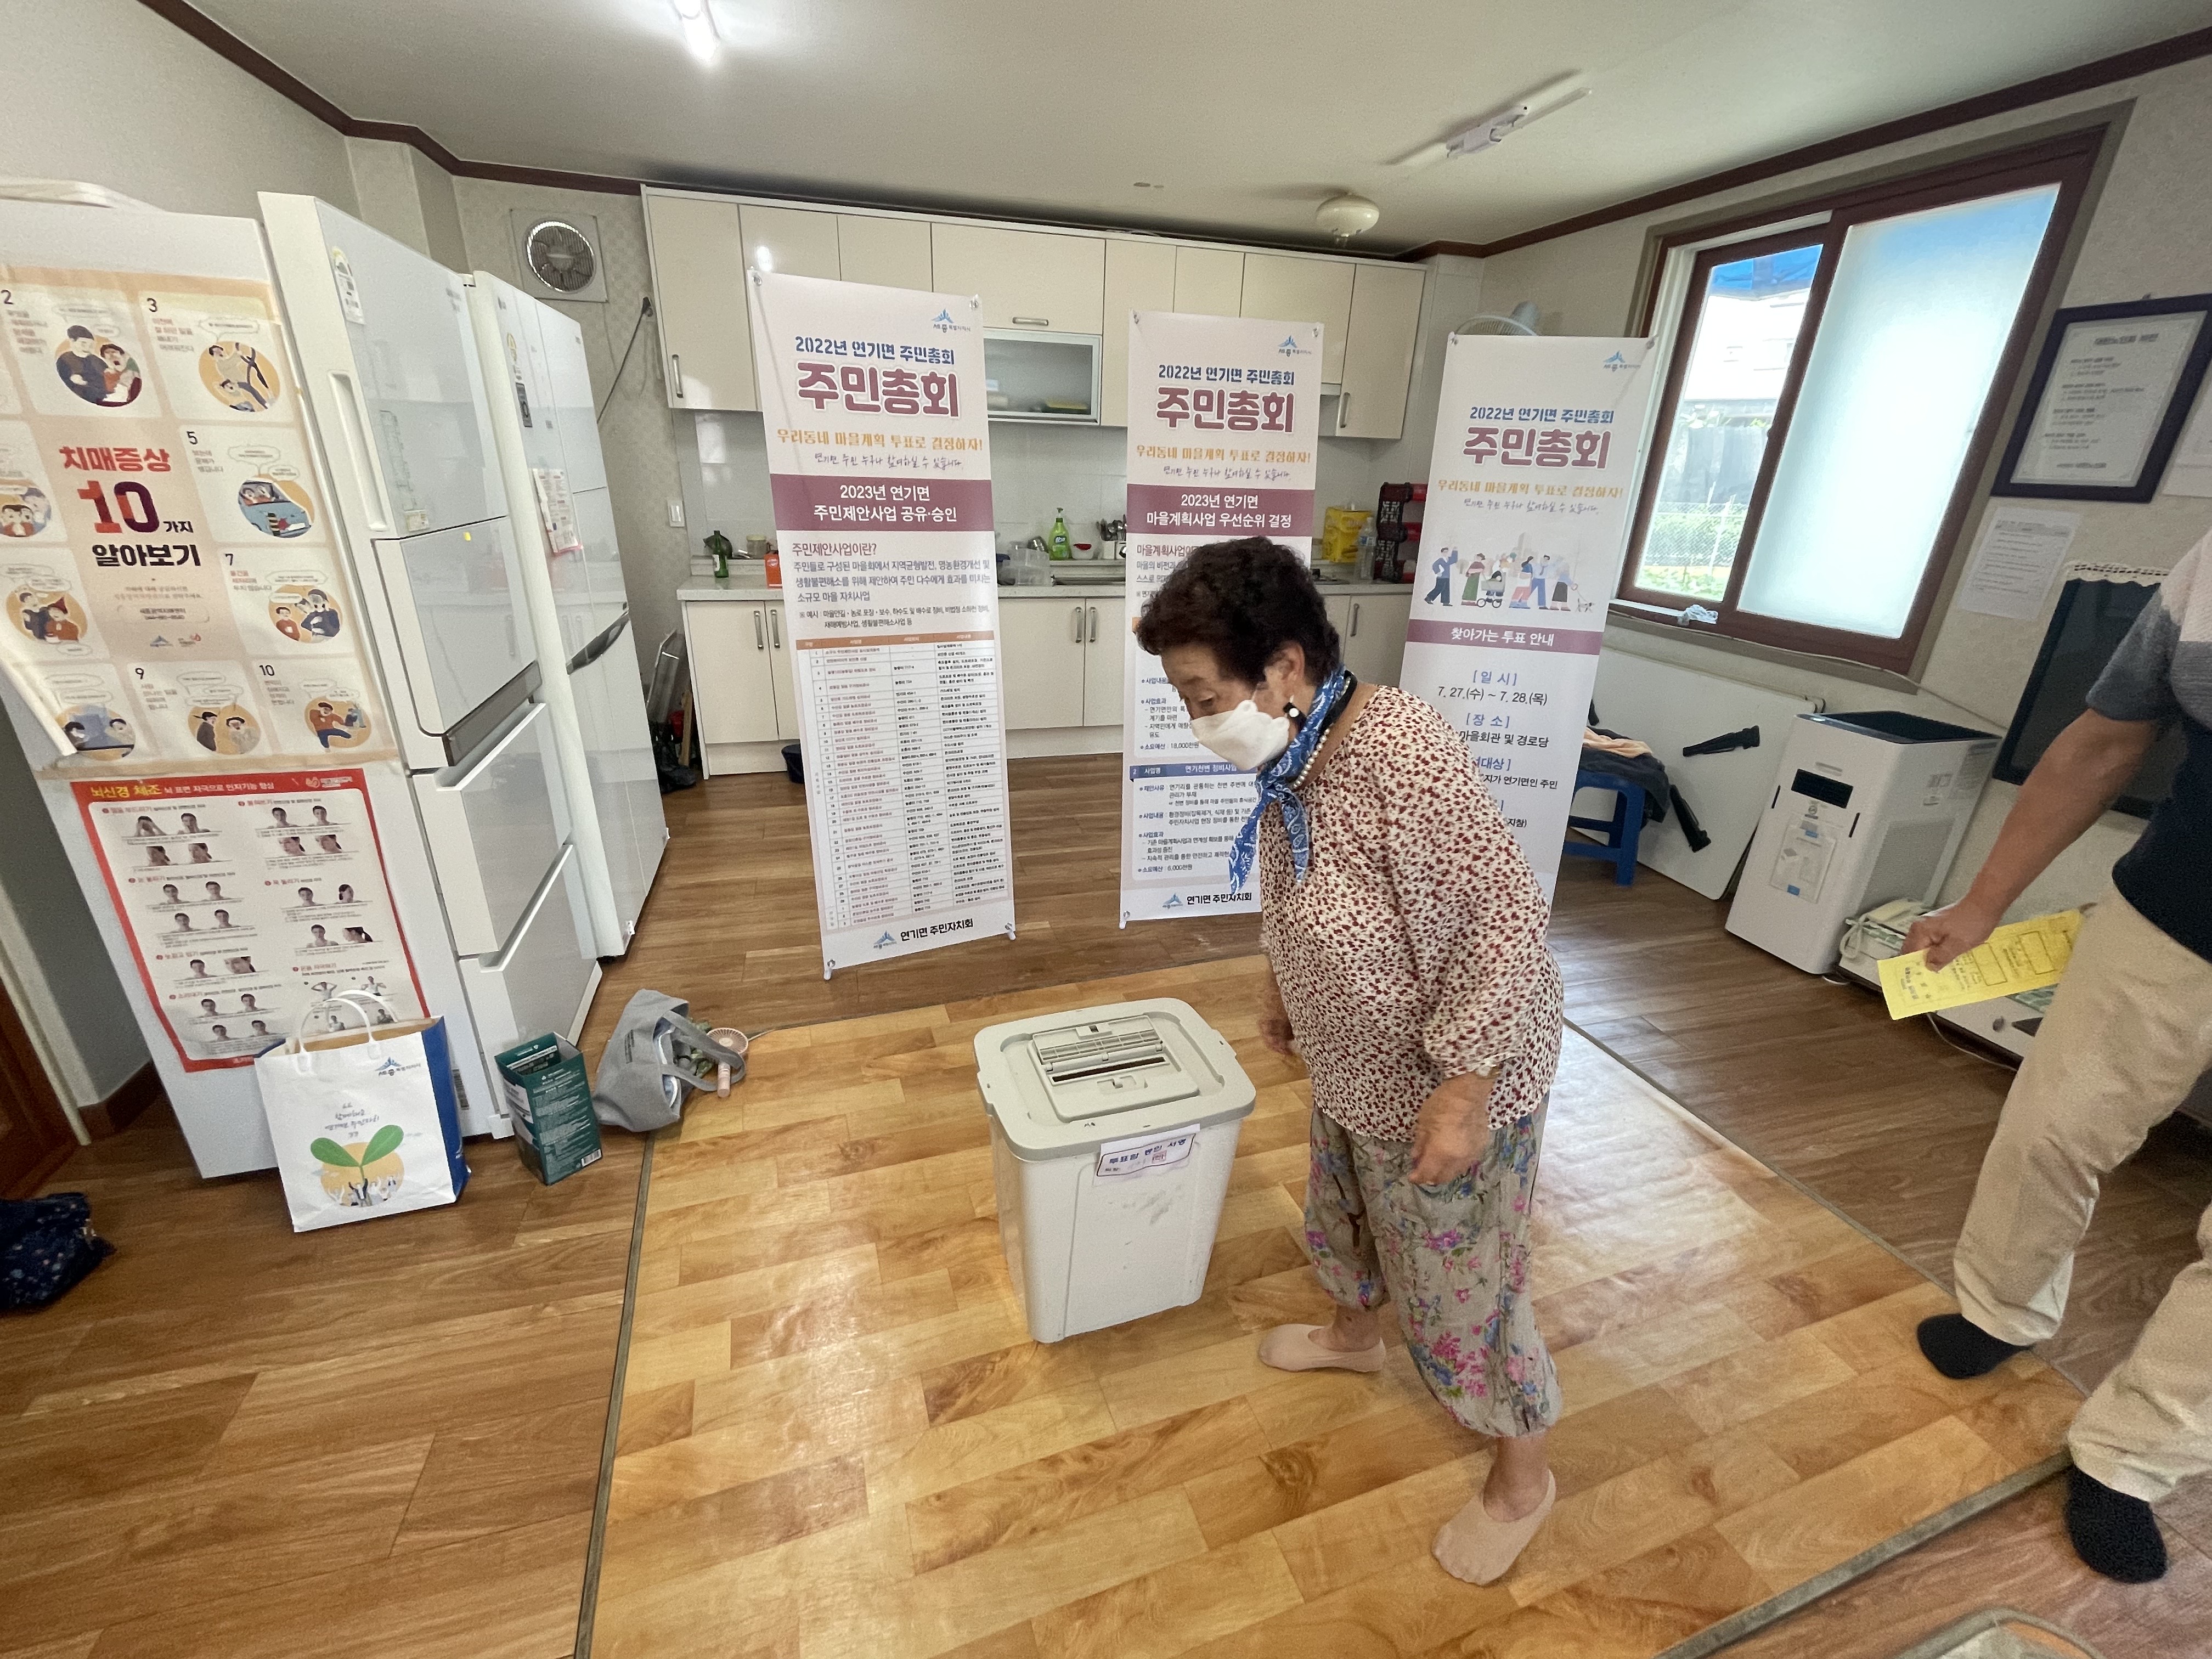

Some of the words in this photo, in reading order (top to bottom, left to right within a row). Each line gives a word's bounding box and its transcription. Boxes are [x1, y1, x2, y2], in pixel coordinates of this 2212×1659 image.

[1, 290, 14, 305] 2
[146, 298, 157, 312] 3
[795, 336, 847, 356] 2022년
[853, 341, 895, 359] 연기면
[900, 346, 955, 365] 주민총회
[1159, 364, 1201, 381] 2022년
[1206, 367, 1242, 383] 연기면
[1246, 369, 1294, 385] 주민총회
[798, 362, 959, 417] 주민총회
[1156, 387, 1294, 433] 주민총회
[1470, 406, 1514, 421] 2022년
[1518, 408, 1557, 422] 연기면
[1561, 409, 1614, 424] 주민총회
[187, 431, 198, 445] 5
[777, 428, 829, 445] 우리동네
[835, 432, 885, 447] 마을계획
[890, 435, 926, 449] 투표로
[932, 437, 983, 451] 결정하자!
[1137, 444, 1177, 459] 우리동네
[1182, 448, 1224, 461] 마을계획
[1229, 449, 1260, 462] 투표로
[1266, 450, 1311, 463] 결정하자!
[1463, 427, 1611, 469] 주민총회
[59, 445, 171, 472] 치매증상
[815, 453, 838, 465] 연기면
[842, 454, 857, 466] 주민
[862, 455, 882, 466] 누구나
[923, 458, 929, 469] 수
[1255, 469, 1261, 479] 수
[840, 484, 885, 501] 2023년
[890, 486, 929, 502] 연기면
[1438, 479, 1481, 492] 우리동네
[1485, 482, 1530, 494] 마을계획
[1534, 484, 1567, 496] 투표로
[1572, 486, 1623, 499] 결정하자!
[1181, 494, 1220, 509] 2023년
[1224, 495, 1258, 509] 연기면
[1560, 503, 1566, 513] 수
[814, 505, 896, 522] 주민제안사업
[1147, 512, 1215, 527] 마을계획사업
[1219, 514, 1265, 528] 우선순위
[1268, 515, 1291, 528] 결정
[92, 544, 201, 567] 알아보기
[792, 543, 877, 556] 주민제안사업이란?
[1137, 544, 1198, 557] 마을계획사업이
[225, 553, 234, 566] 7
[794, 561, 825, 573] 주민들로
[827, 561, 850, 572] 구성된
[852, 561, 890, 571] 마을회에서
[983, 560, 990, 569] 및
[1137, 561, 1155, 569] 마을의
[796, 577, 849, 588] 생활불편해소를
[852, 576, 867, 586] 위해
[869, 576, 898, 586] 제안하여
[900, 575, 915, 585] 주민
[917, 575, 945, 585] 다수에게
[947, 574, 967, 584] 효과를
[969, 574, 991, 584] 미치는
[798, 592, 821, 602] 소규모
[822, 592, 837, 602] 마을
[840, 591, 870, 601] 자치사업
[1451, 627, 1499, 642] 찾아가는
[1501, 629, 1526, 644] 투표
[1530, 631, 1554, 647] 안내
[135, 668, 144, 680] 9
[259, 665, 275, 676] 10
[1504, 734, 1514, 745] 및
[1517, 735, 1549, 748] 경로당
[1504, 776, 1538, 787] 연기면인
[1540, 780, 1558, 790] 주민
[91, 785, 130, 798] 뇌신경
[134, 785, 162, 795] 체조
[1187, 895, 1211, 905] 연기면
[1212, 892, 1252, 902] 주민자치회
[900, 928, 928, 941] 연기면
[930, 918, 973, 935] 주민자치회
